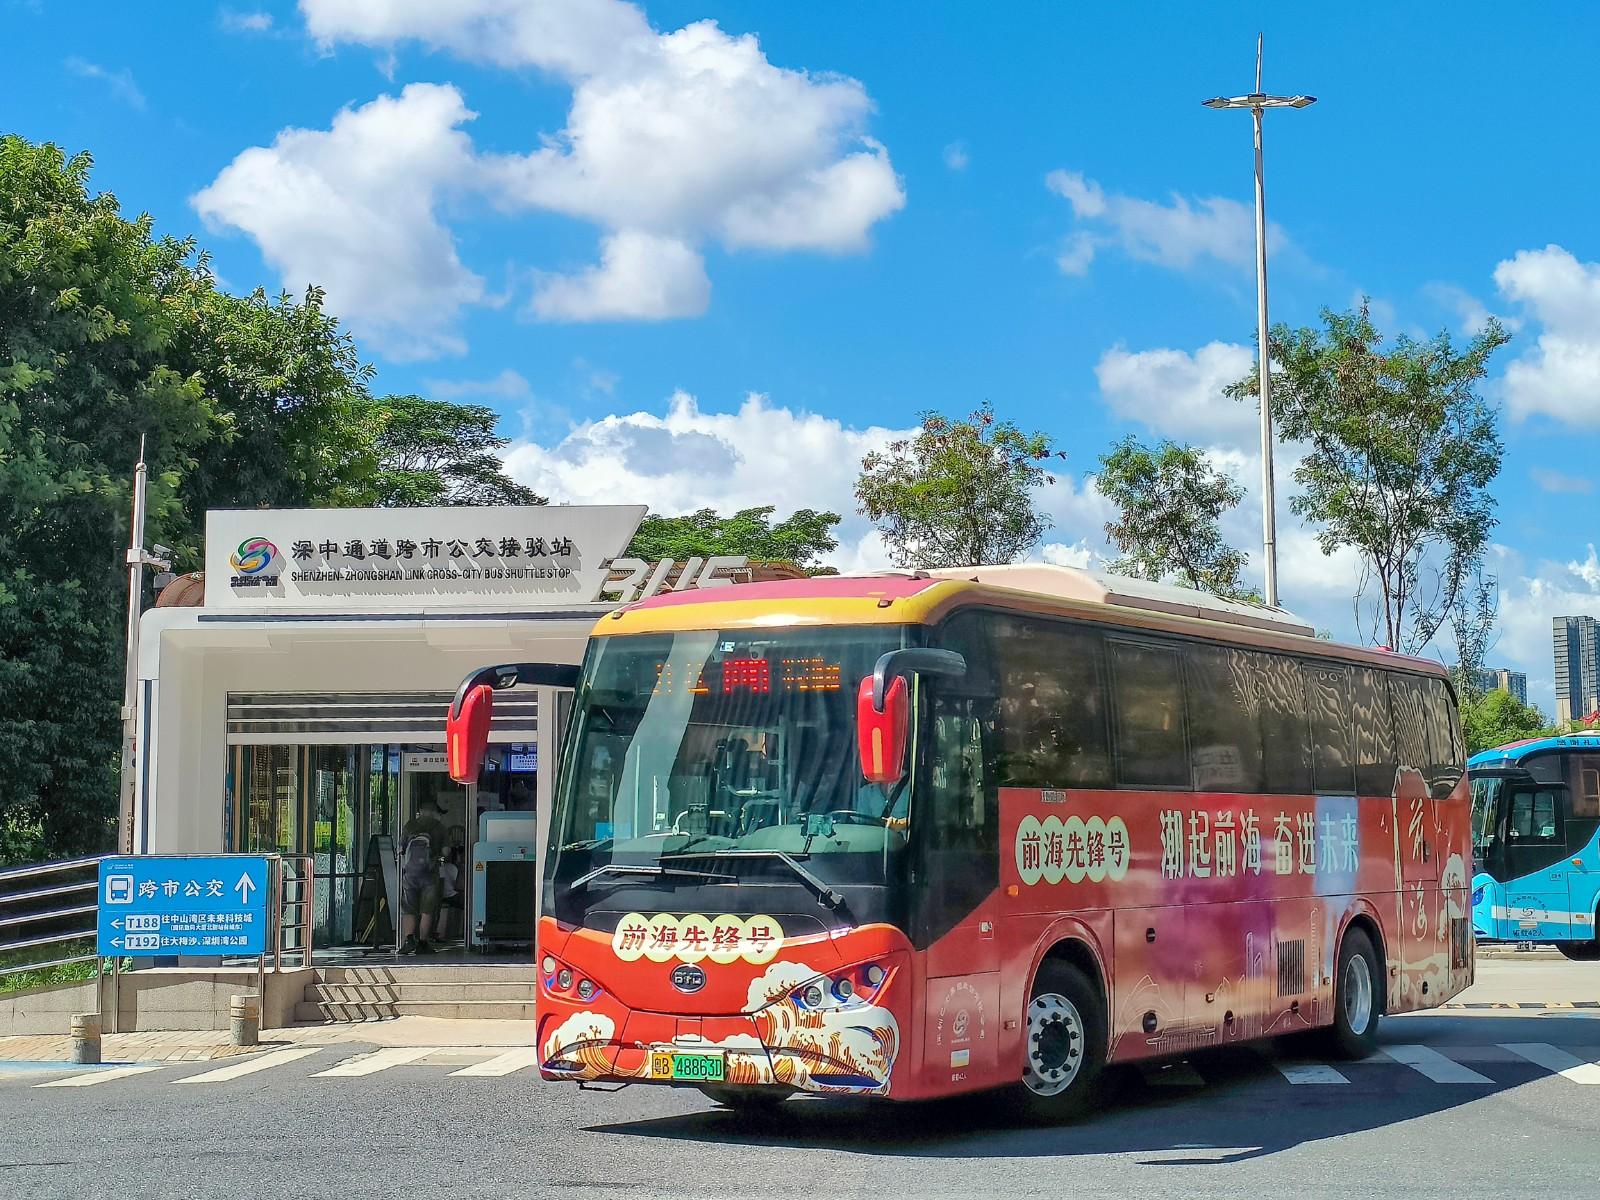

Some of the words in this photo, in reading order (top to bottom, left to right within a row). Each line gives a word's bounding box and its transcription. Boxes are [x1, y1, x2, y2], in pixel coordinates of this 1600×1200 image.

[291, 536, 573, 561] 深中通道跨市公交接驳站
[291, 569, 402, 582] SHENZHEN-ZHONGSHAN
[404, 568, 425, 581] LINK
[427, 568, 482, 580] CROSS-CITY
[484, 568, 503, 580] BUS
[505, 568, 545, 580] SHUTTLE
[546, 567, 571, 580] STOP
[1021, 830, 1125, 870] 前海先锋号
[1159, 808, 1262, 880] 潮起前海
[1273, 810, 1360, 876] 奋进未来
[138, 878, 225, 898] 跨市公交
[127, 917, 158, 929] T188
[161, 912, 253, 924] 往中山湾区未来科技城
[126, 936, 158, 947] T192
[160, 935, 248, 946] 往大梅沙、深圳湾公园
[619, 923, 775, 954] 前海先锋号
[674, 971, 702, 984] BYD
